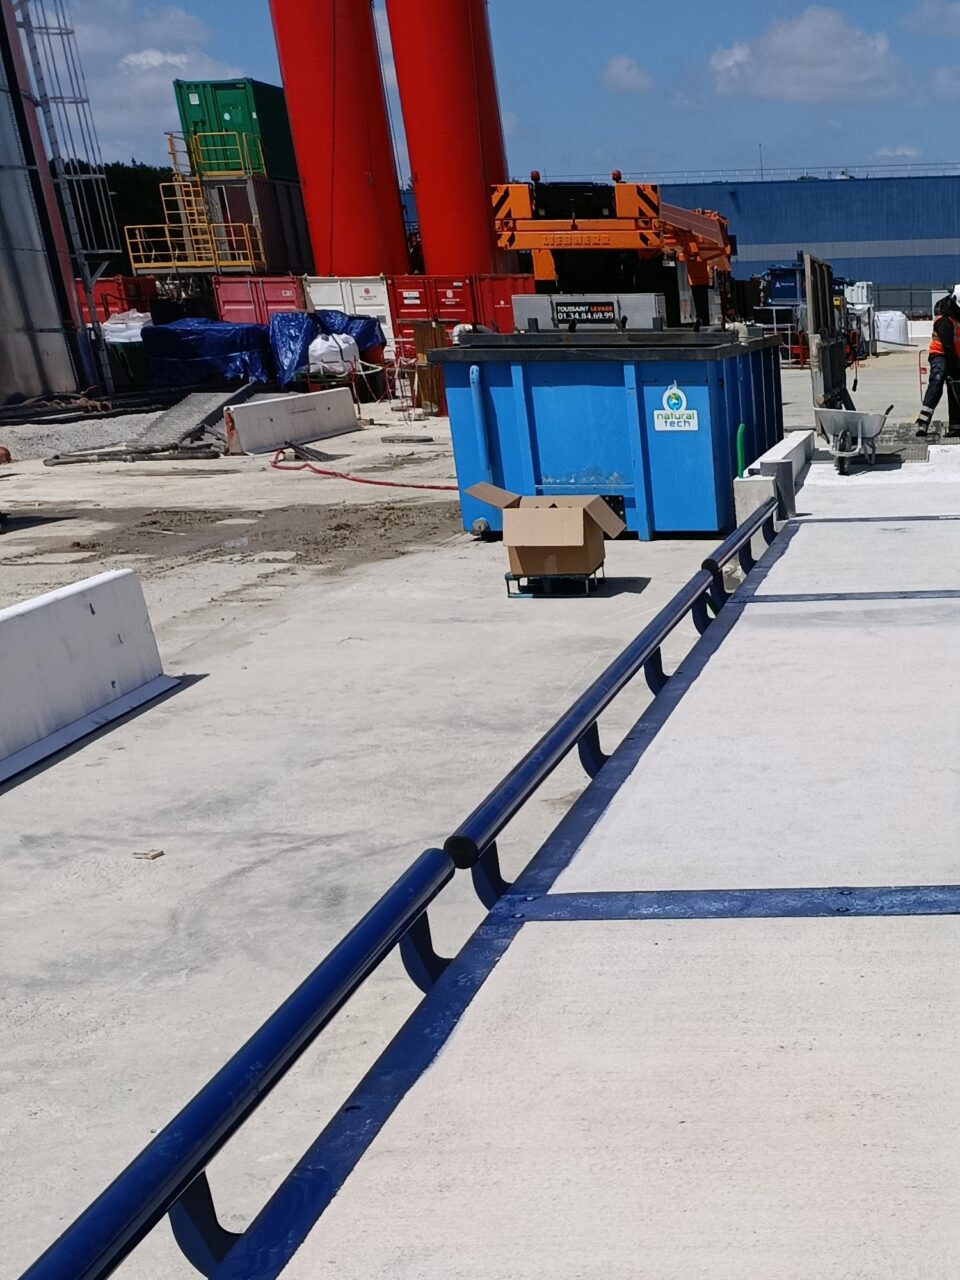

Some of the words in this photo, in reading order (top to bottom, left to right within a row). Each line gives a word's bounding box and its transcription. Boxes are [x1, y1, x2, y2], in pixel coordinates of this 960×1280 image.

[557, 312, 614, 320] 01.34.84.69.99
[656, 412, 695, 420] natural
[664, 419, 691, 428] tech
